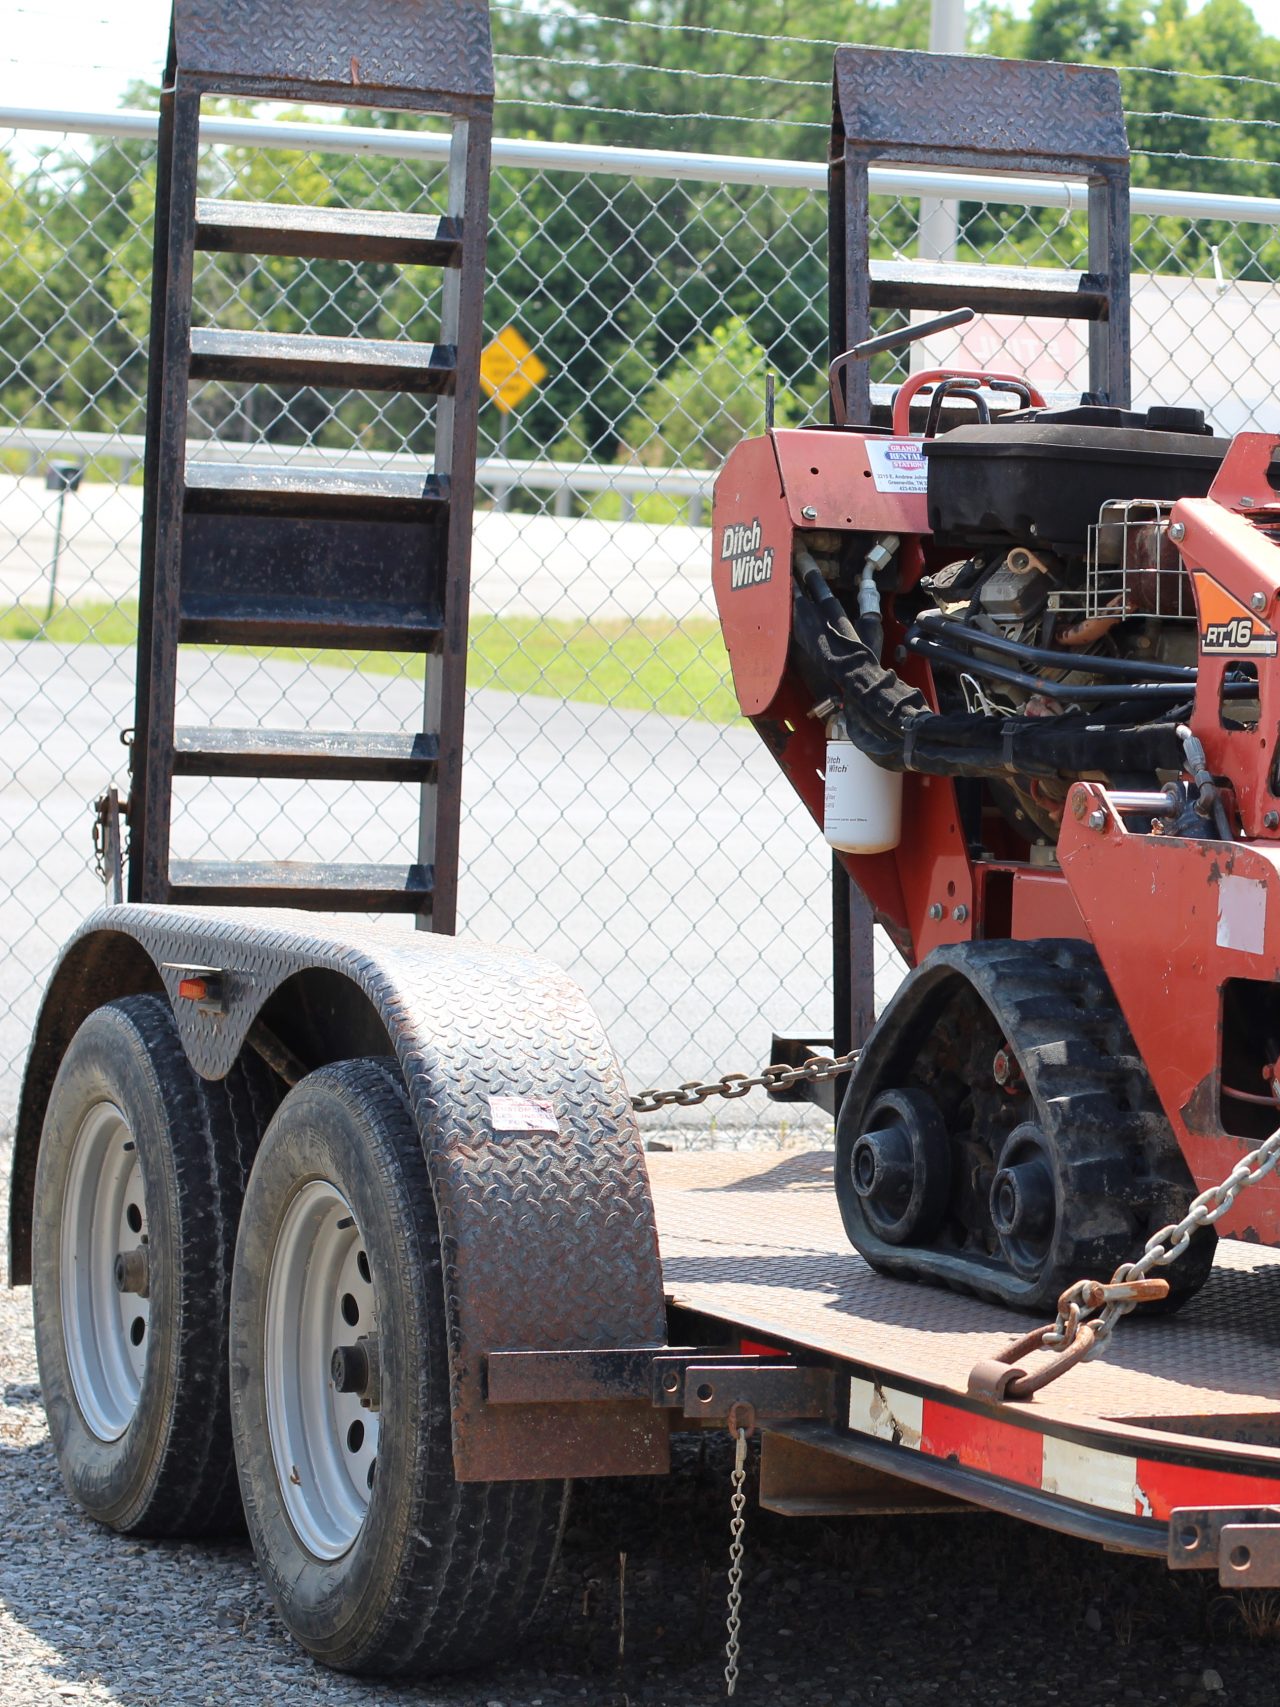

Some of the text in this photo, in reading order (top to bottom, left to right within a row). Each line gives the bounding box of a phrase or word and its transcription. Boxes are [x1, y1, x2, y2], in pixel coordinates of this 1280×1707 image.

[889, 452, 922, 460] RENTAL
[722, 520, 761, 559] Ditch
[732, 549, 773, 588] Witch
[1206, 620, 1252, 644] RT16
[828, 764, 848, 773] Witch
